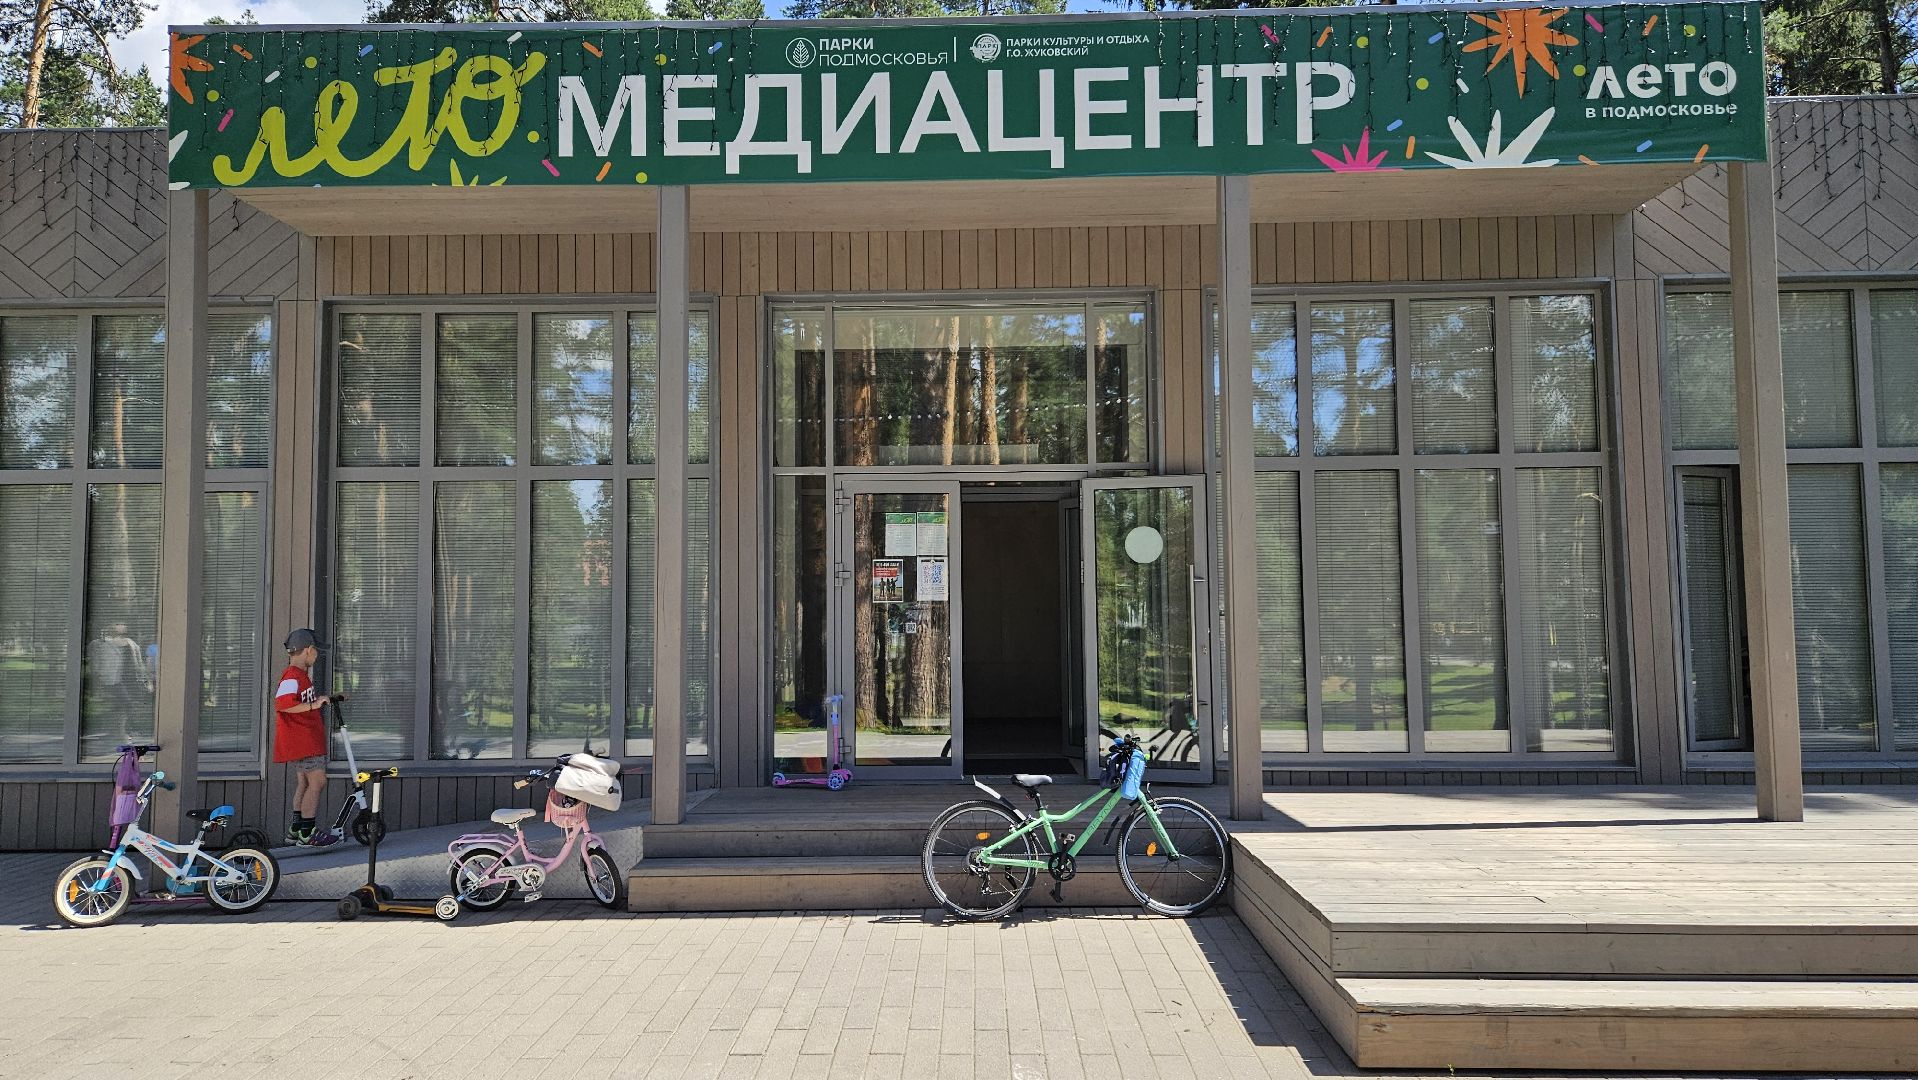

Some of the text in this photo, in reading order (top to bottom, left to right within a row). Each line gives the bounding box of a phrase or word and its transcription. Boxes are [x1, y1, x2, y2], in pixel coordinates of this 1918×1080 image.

[819, 37, 874, 51] ПАРКИ
[1006, 34, 1150, 47] ПАРКИ КУЛЬТУРЫ И ОТДЫХА
[1006, 45, 1089, 58] Г.О. ЖУКОВСКИЙ
[819, 52, 948, 67] ПОДМОСКОВЬЯ
[558, 62, 1356, 174] МЕДИАЦЕНТР
